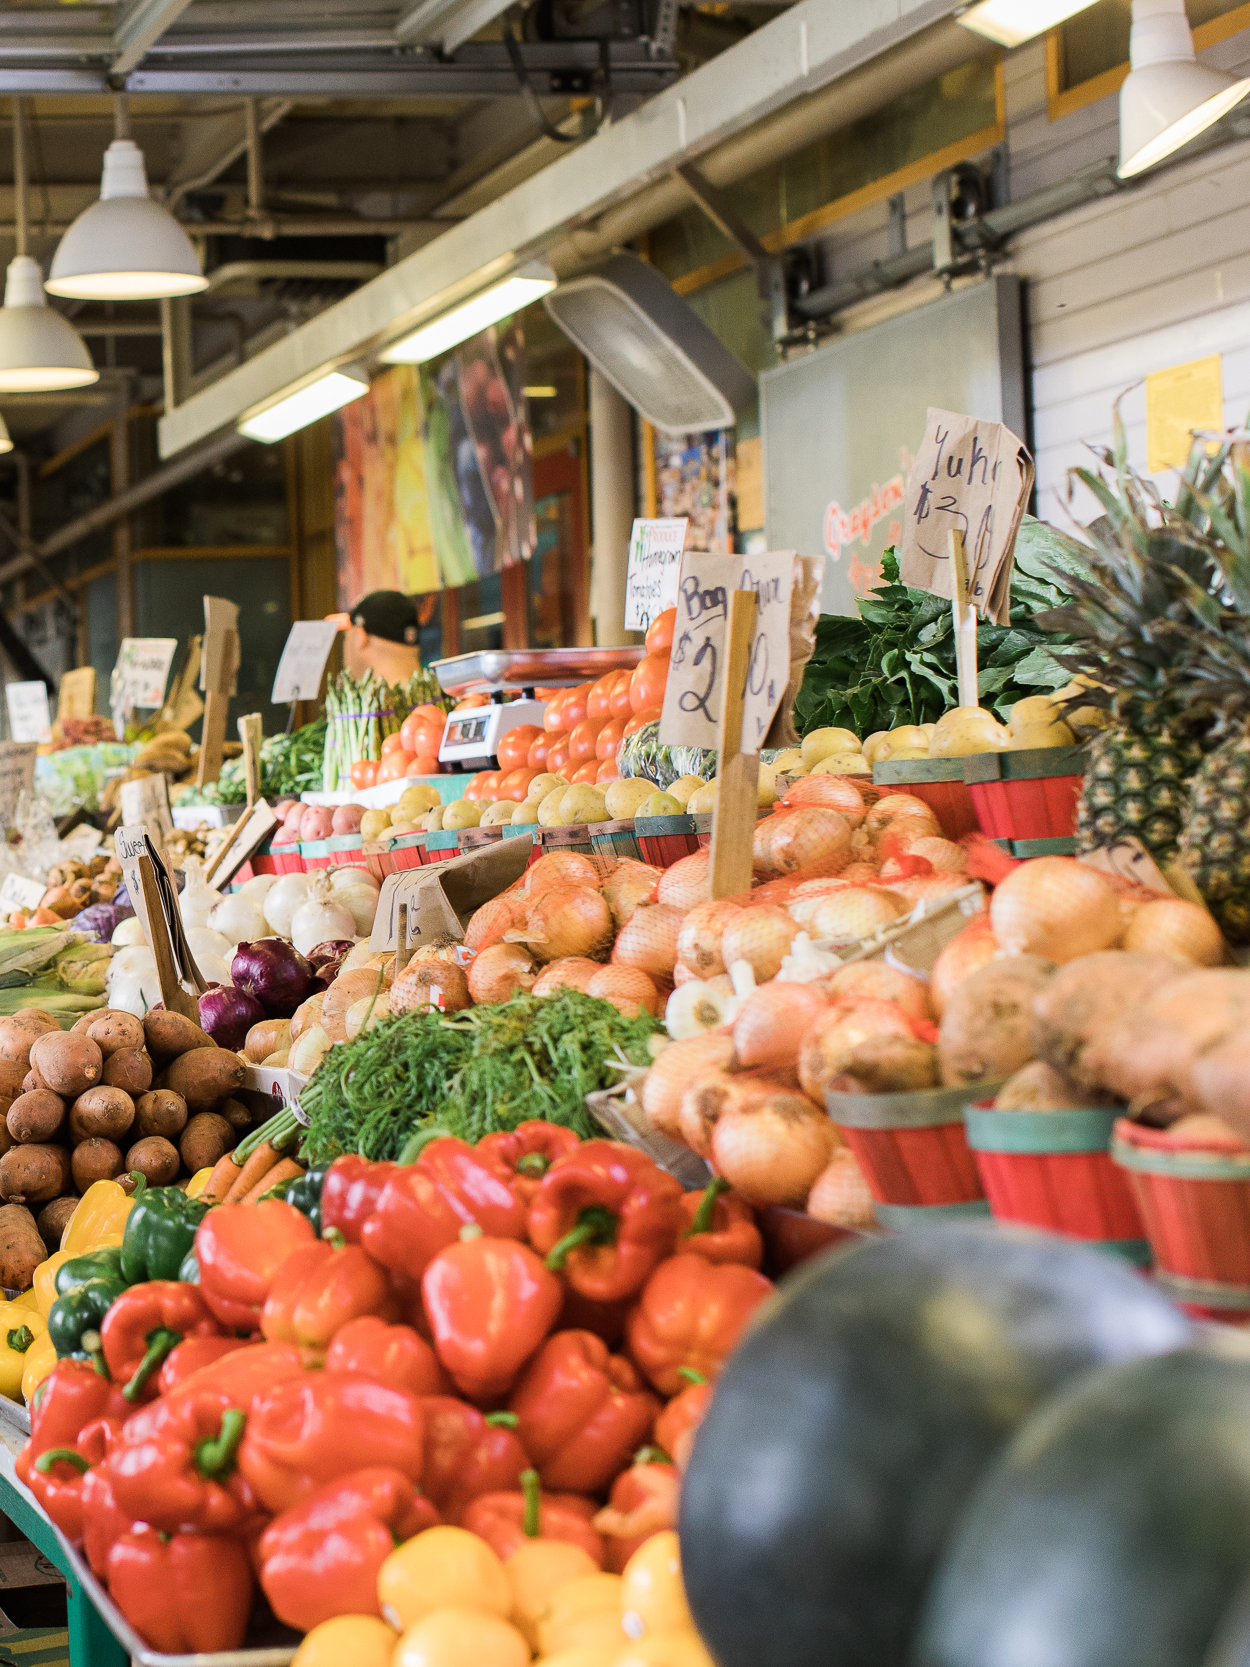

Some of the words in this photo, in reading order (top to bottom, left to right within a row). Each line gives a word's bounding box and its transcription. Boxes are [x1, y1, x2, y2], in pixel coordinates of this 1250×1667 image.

[648, 526, 678, 543] PRODUCE
[641, 542, 682, 576] Homegrown
[627, 572, 662, 600] Tomatoes
